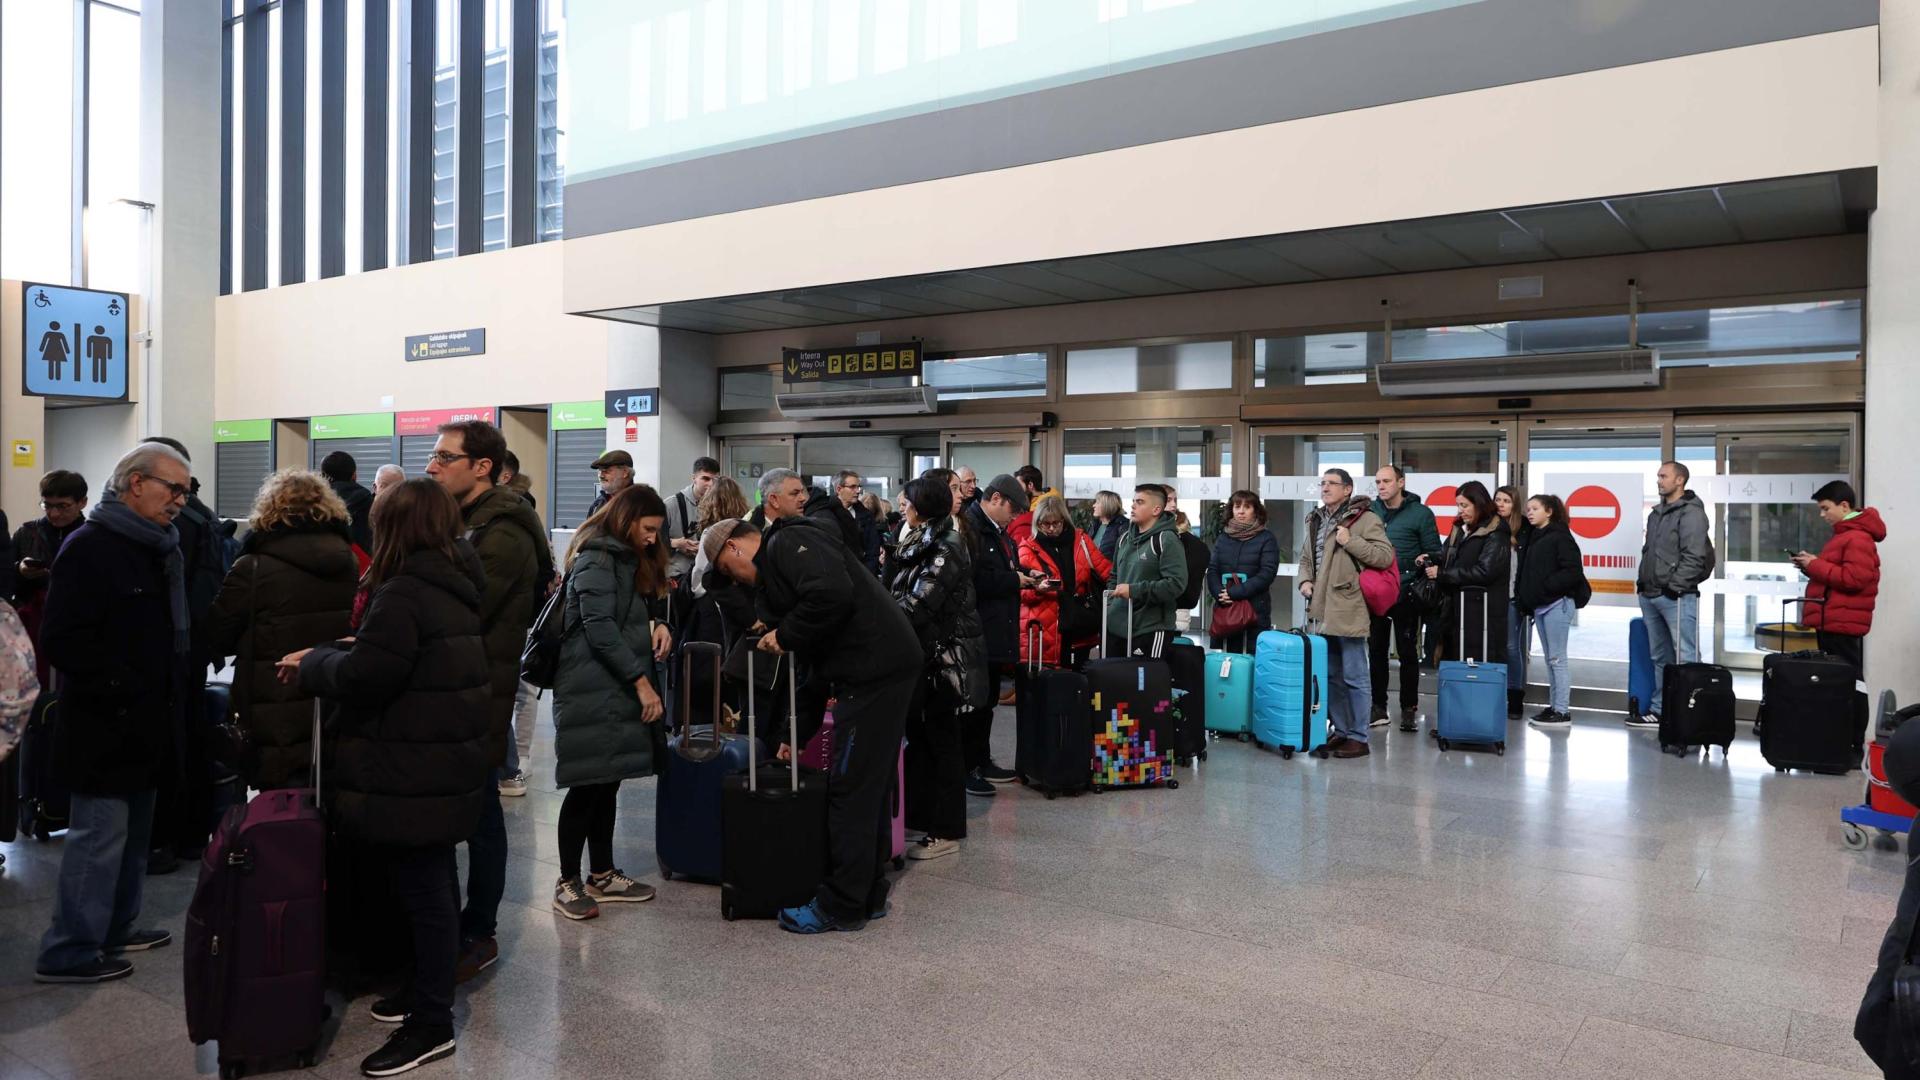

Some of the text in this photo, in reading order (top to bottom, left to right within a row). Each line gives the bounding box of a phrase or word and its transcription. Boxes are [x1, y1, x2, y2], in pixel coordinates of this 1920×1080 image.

[800, 351, 820, 360] Irteera
[800, 360, 825, 369] Way Out
[801, 370, 819, 379] Salida
[451, 413, 478, 423] IBERIA
